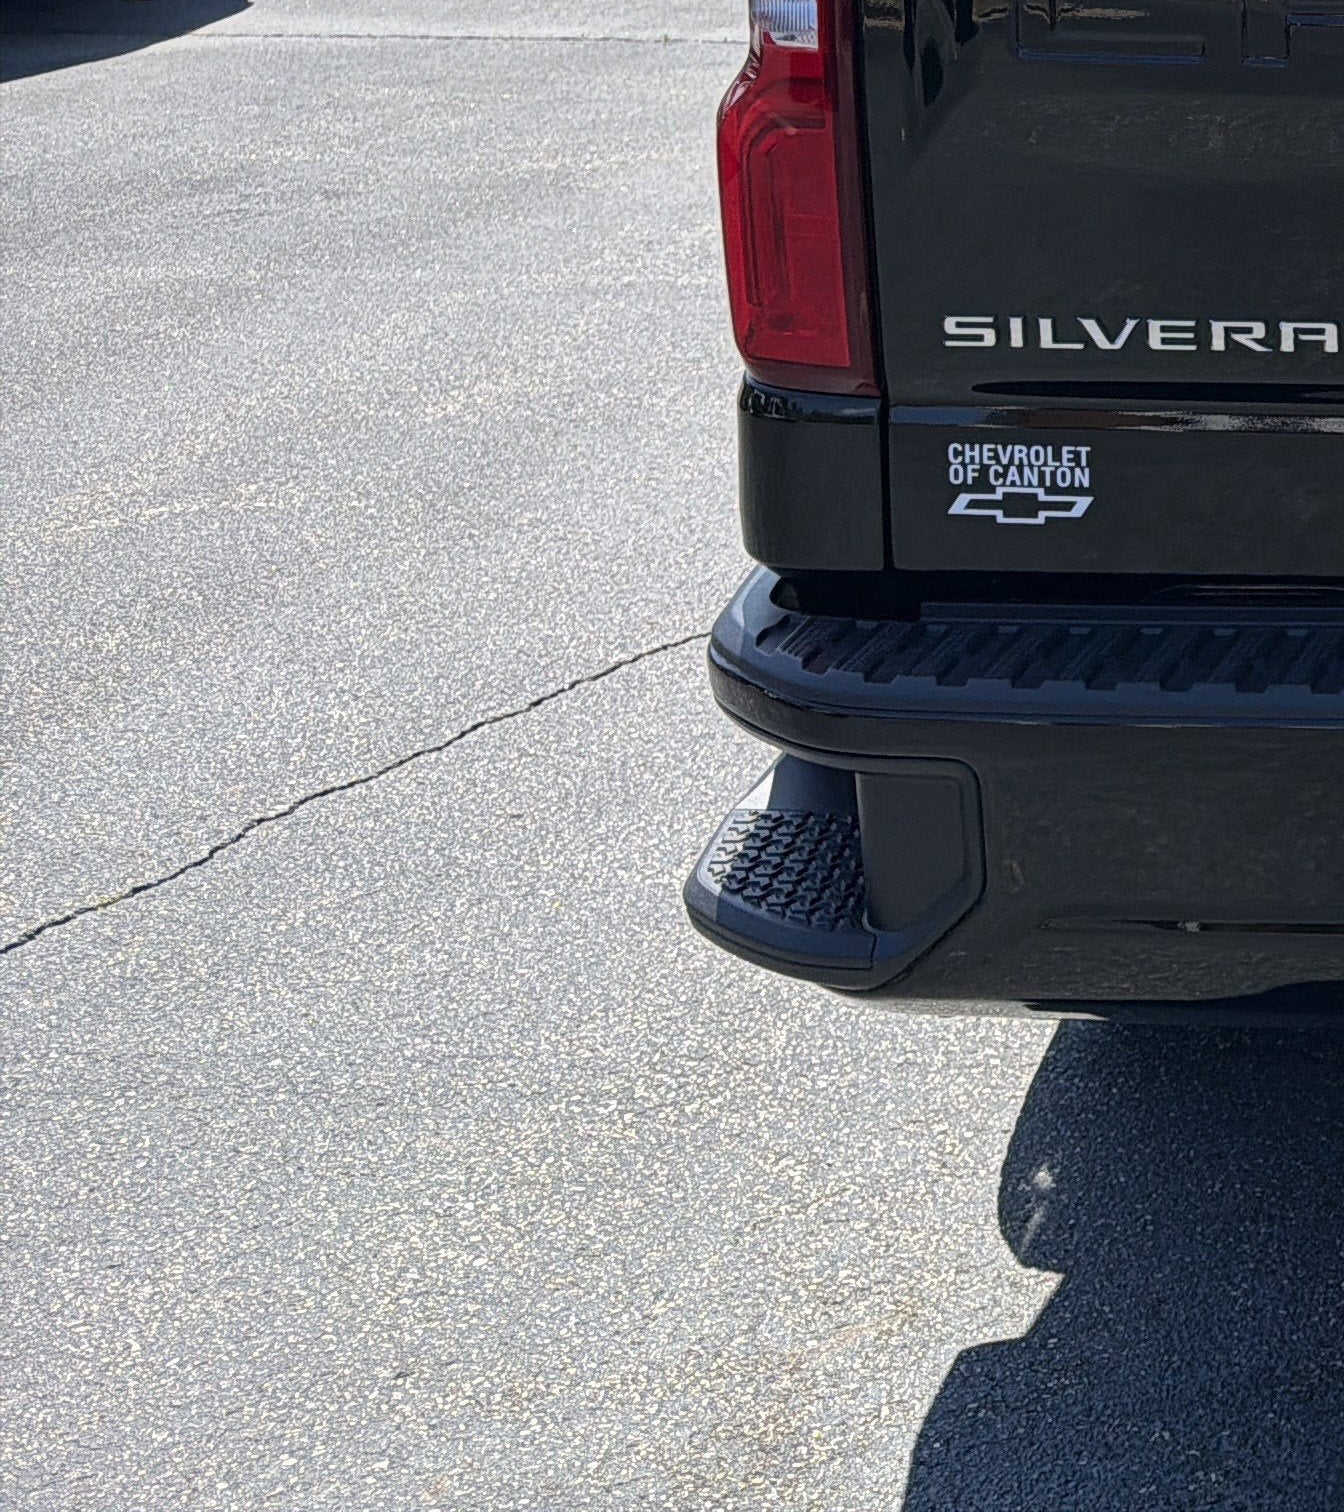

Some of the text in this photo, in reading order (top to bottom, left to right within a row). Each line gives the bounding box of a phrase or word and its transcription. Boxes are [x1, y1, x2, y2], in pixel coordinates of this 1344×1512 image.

[948, 443, 1091, 468] CHEVROLET
[949, 464, 1090, 488] OF CANTON
